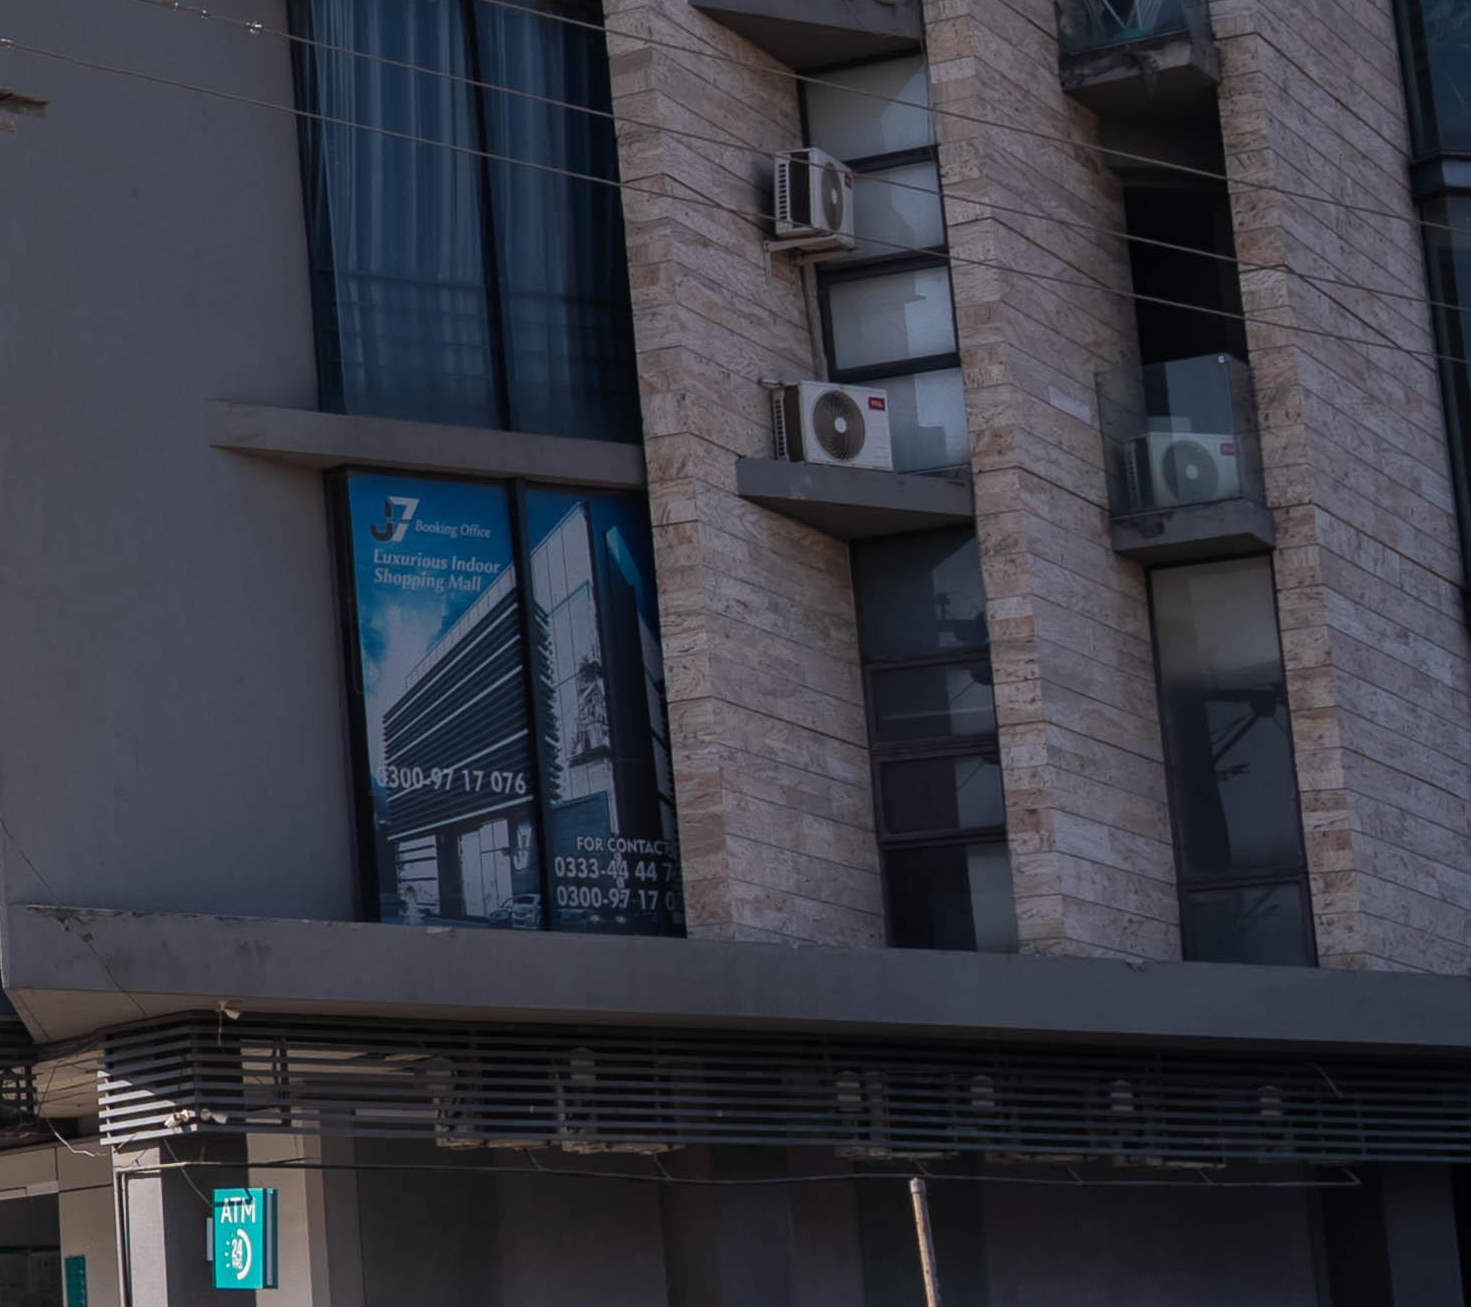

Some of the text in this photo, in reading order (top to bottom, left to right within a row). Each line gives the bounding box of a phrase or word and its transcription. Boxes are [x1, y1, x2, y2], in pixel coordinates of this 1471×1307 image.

[415, 519, 491, 539] Booking Office
[373, 548, 502, 575] Luxurious Indoor
[373, 567, 482, 592] Shopping Mall
[376, 765, 527, 795] 0300-97 17 076
[576, 836, 604, 852] FOR
[554, 856, 630, 880] 0333-44
[635, 861, 659, 881] 44
[556, 885, 631, 909] 0300-97
[638, 889, 659, 911] 17
[220, 1196, 256, 1224] ATM
[231, 1238, 243, 1258] 24
